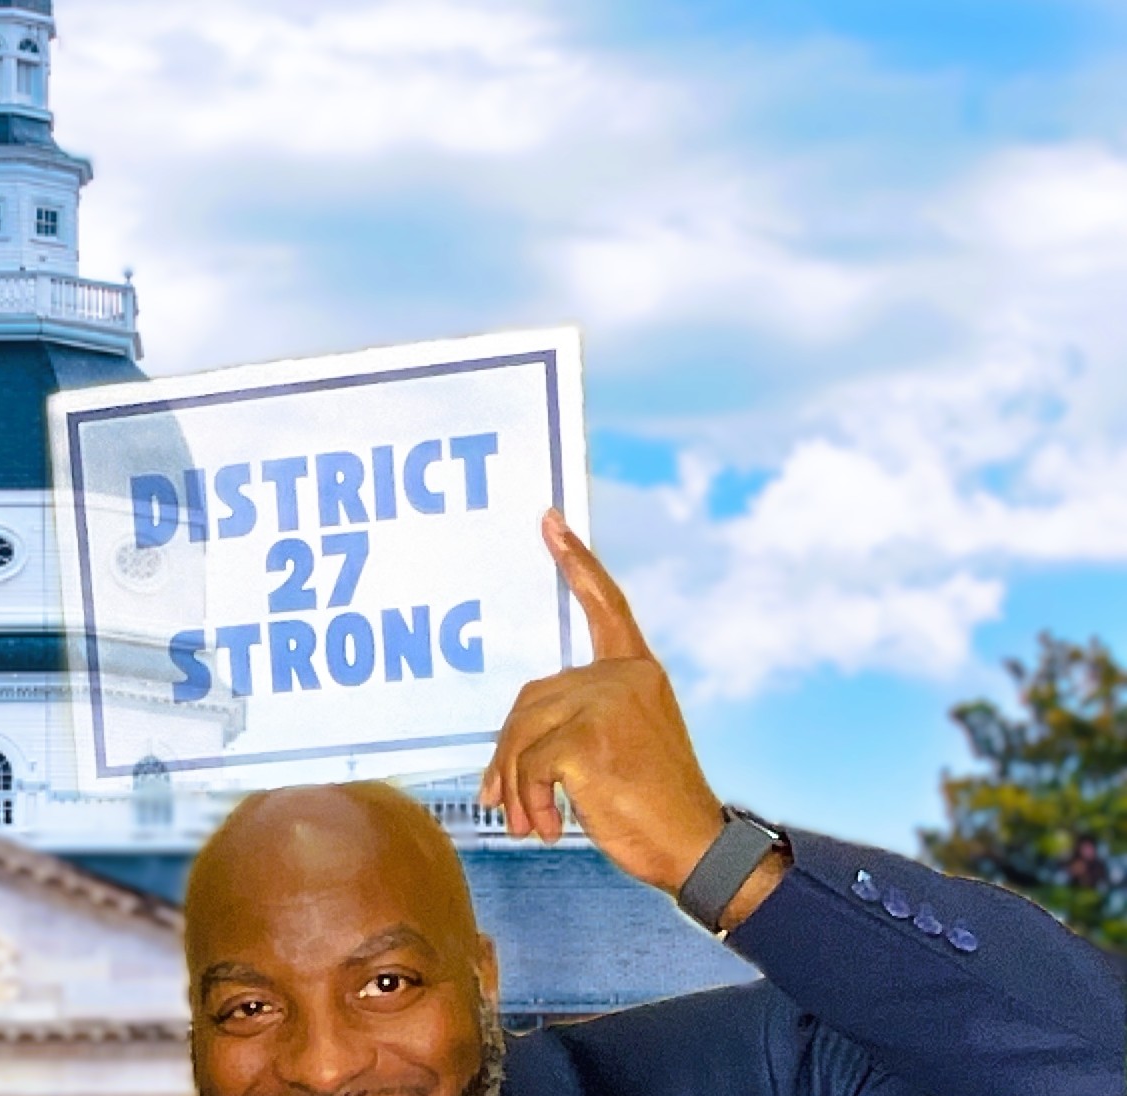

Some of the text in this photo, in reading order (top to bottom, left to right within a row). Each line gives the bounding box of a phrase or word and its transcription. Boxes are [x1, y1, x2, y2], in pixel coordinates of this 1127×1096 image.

[130, 432, 498, 549] DISTRICT
[265, 531, 369, 614] 27
[168, 599, 484, 702] STRONG
